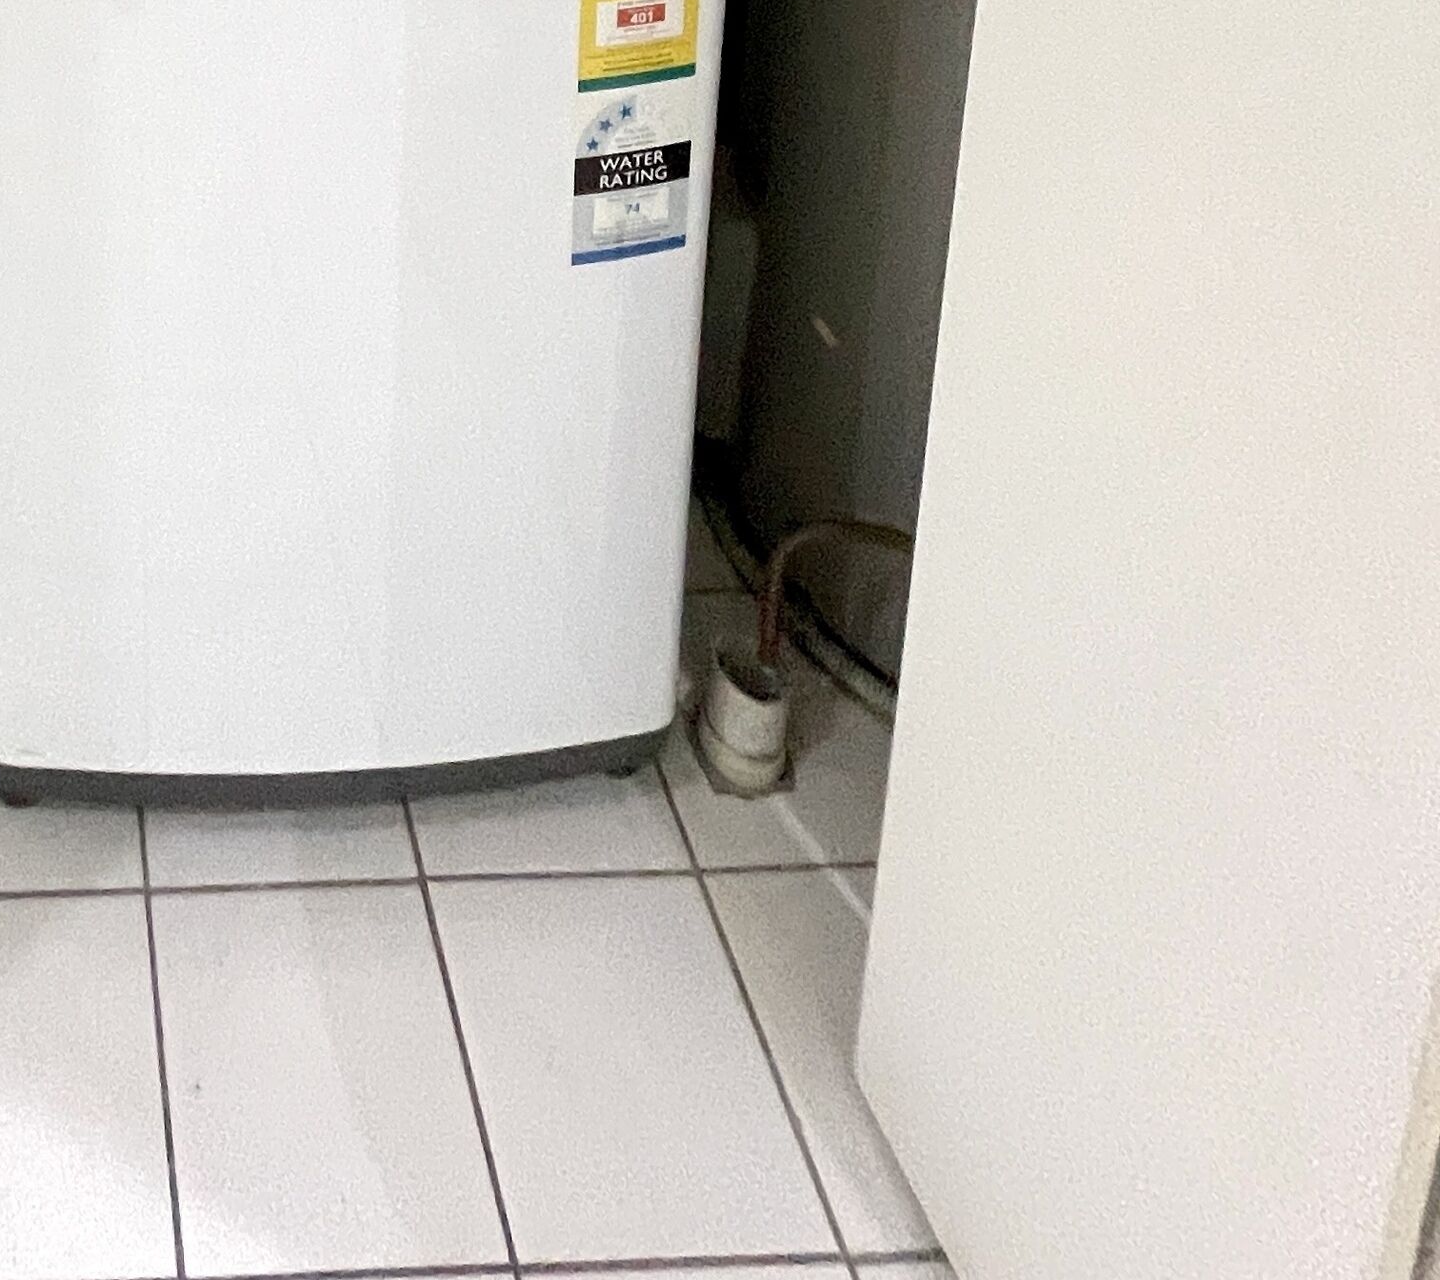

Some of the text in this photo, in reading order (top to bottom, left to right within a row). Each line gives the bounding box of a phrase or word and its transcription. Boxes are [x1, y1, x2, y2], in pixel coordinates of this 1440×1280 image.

[630, 9, 654, 25] 401
[599, 150, 665, 172] WATER
[598, 165, 668, 190] RATING
